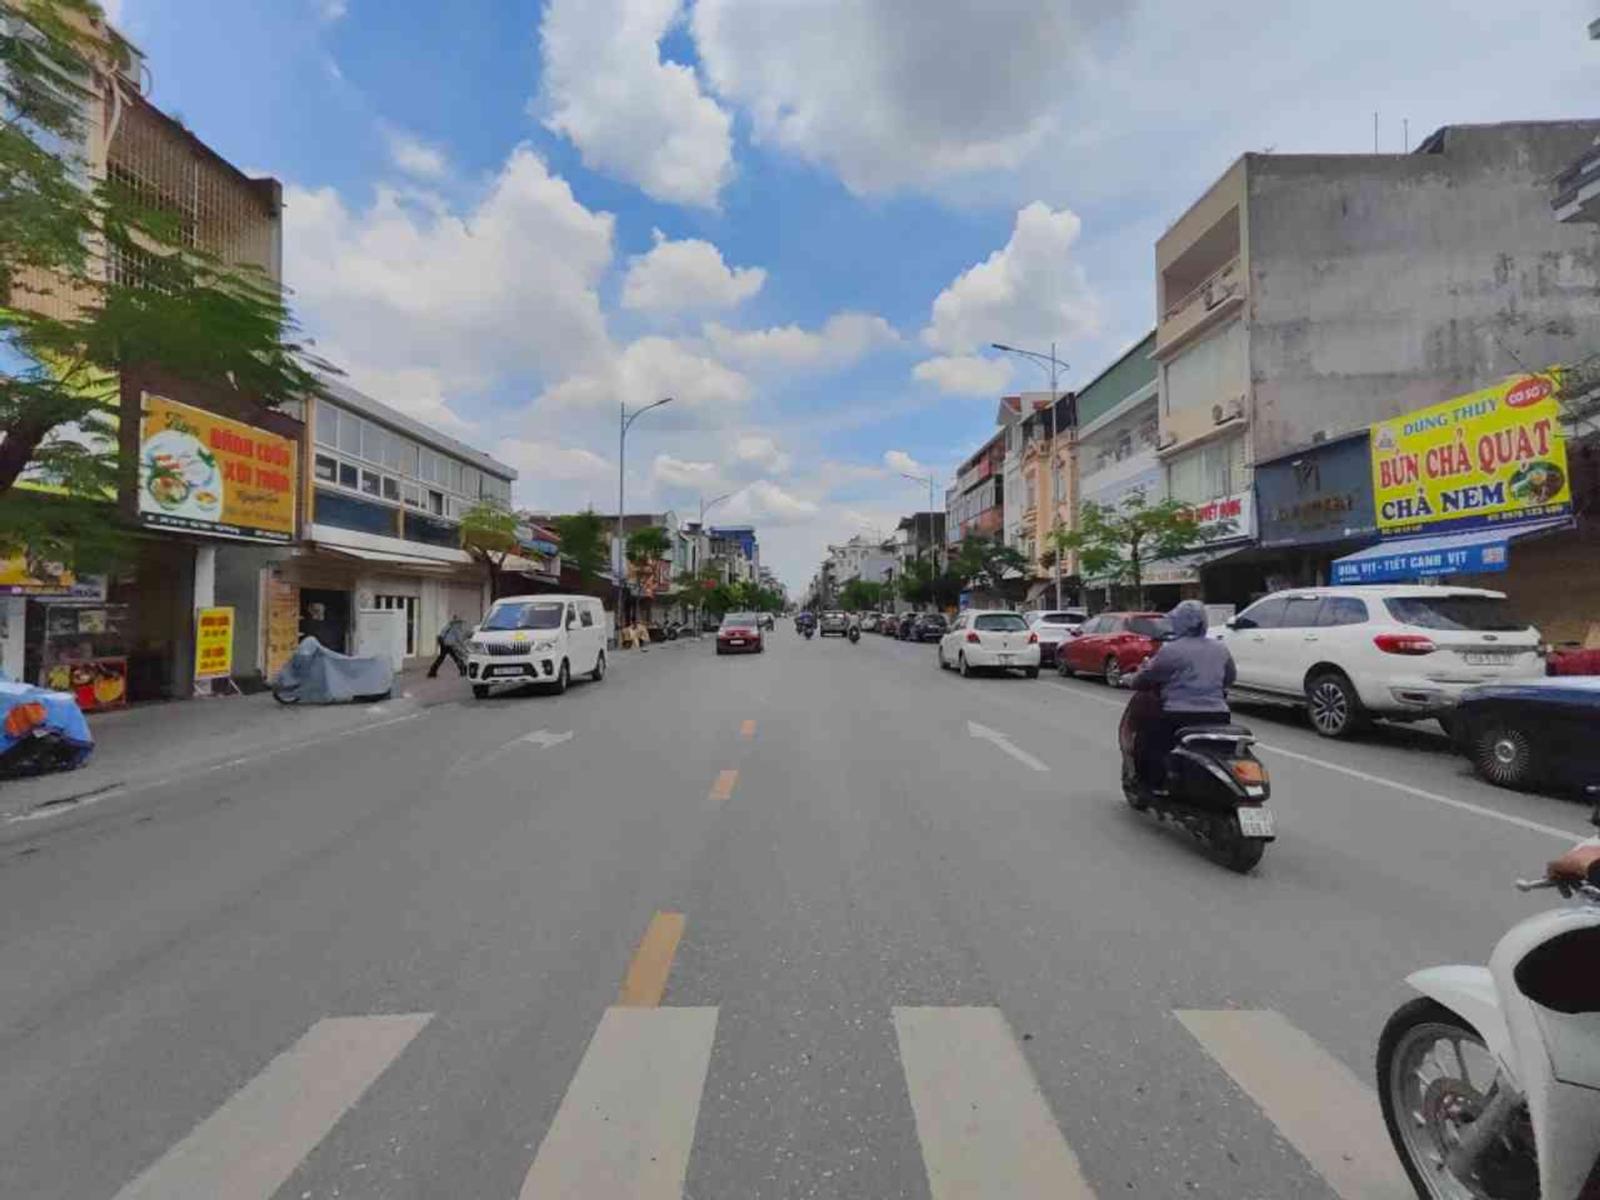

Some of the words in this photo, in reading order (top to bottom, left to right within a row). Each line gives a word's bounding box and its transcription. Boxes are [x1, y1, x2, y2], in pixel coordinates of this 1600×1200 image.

[1379, 447, 1419, 488] BÚN
[1426, 428, 1472, 478] CHẢ
[1479, 418, 1551, 475] QUẠT
[1382, 488, 1433, 521] CHẢ
[1440, 482, 1506, 512] NEM
[1448, 551, 1467, 566] VỊT
